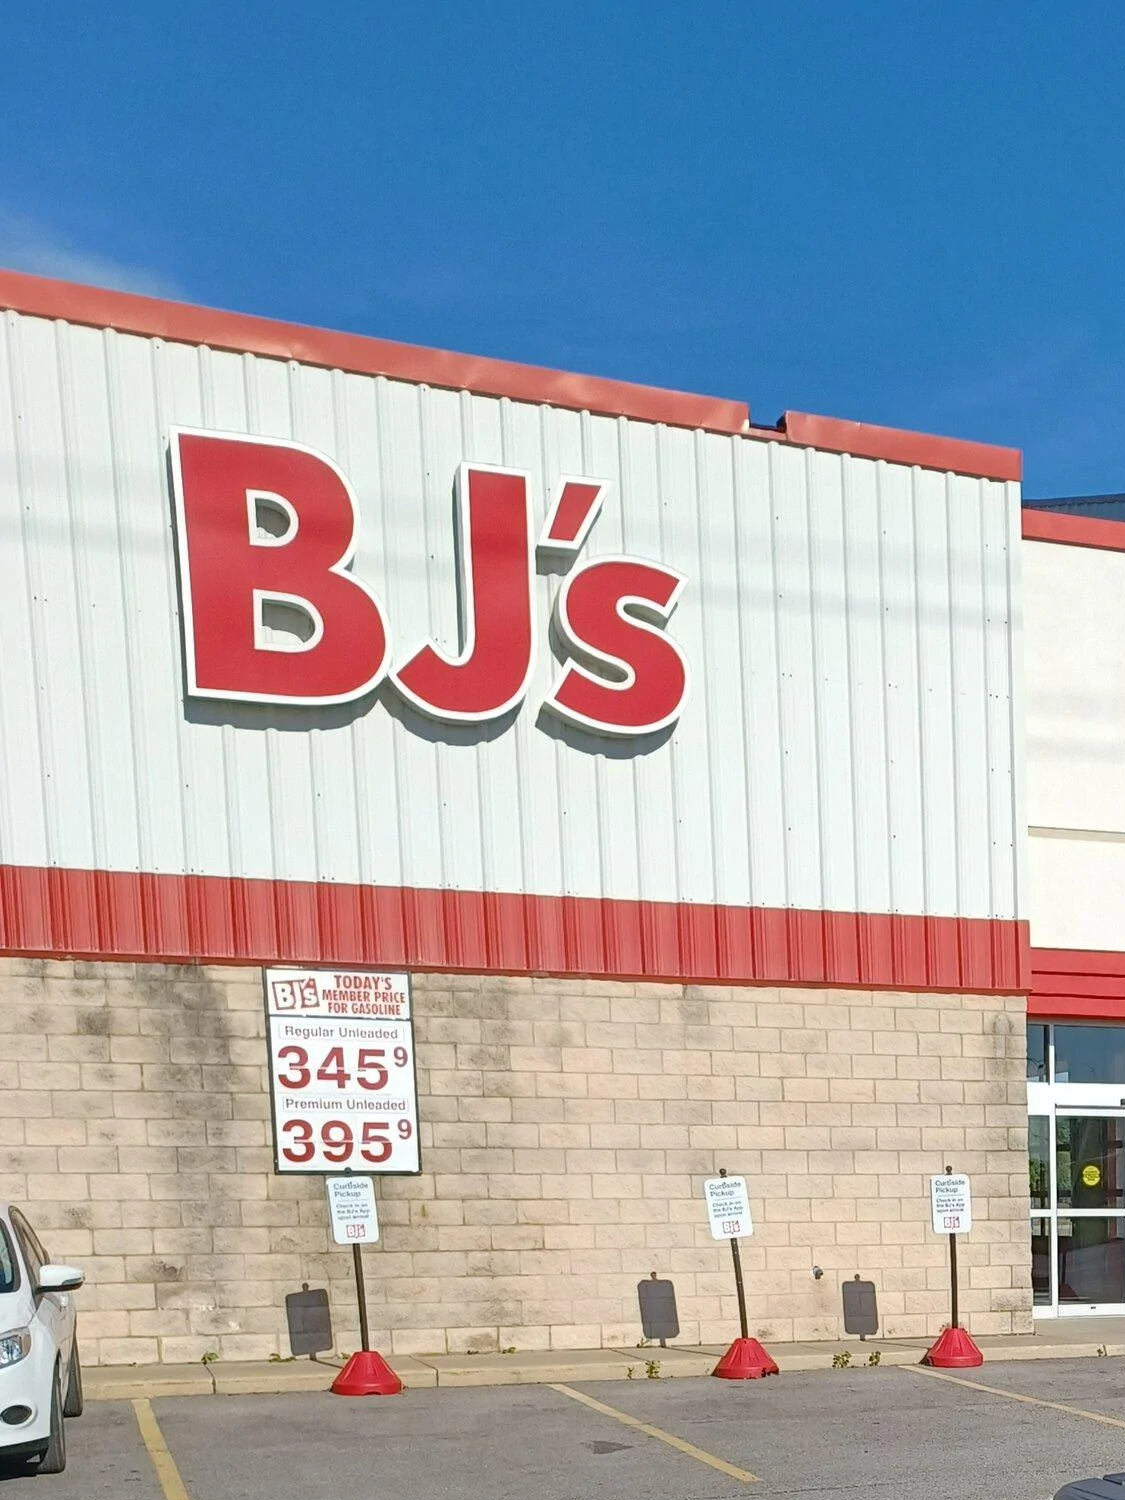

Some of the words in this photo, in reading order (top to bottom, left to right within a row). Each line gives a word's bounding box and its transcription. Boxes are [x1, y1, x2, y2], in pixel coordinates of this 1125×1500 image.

[167, 424, 693, 736] BJ's
[333, 975, 393, 990] TODAY'S
[272, 977, 320, 1010] BJ's
[322, 990, 370, 1002] MEMBER
[374, 992, 406, 1004] PRICE
[328, 1002, 348, 1014] FOR
[351, 1003, 401, 1016] GASOLINE
[285, 1026, 334, 1039] Regular
[339, 1027, 398, 1039] Unleaded
[285, 1098, 342, 1110] Premium
[346, 1099, 406, 1110] Unleaded
